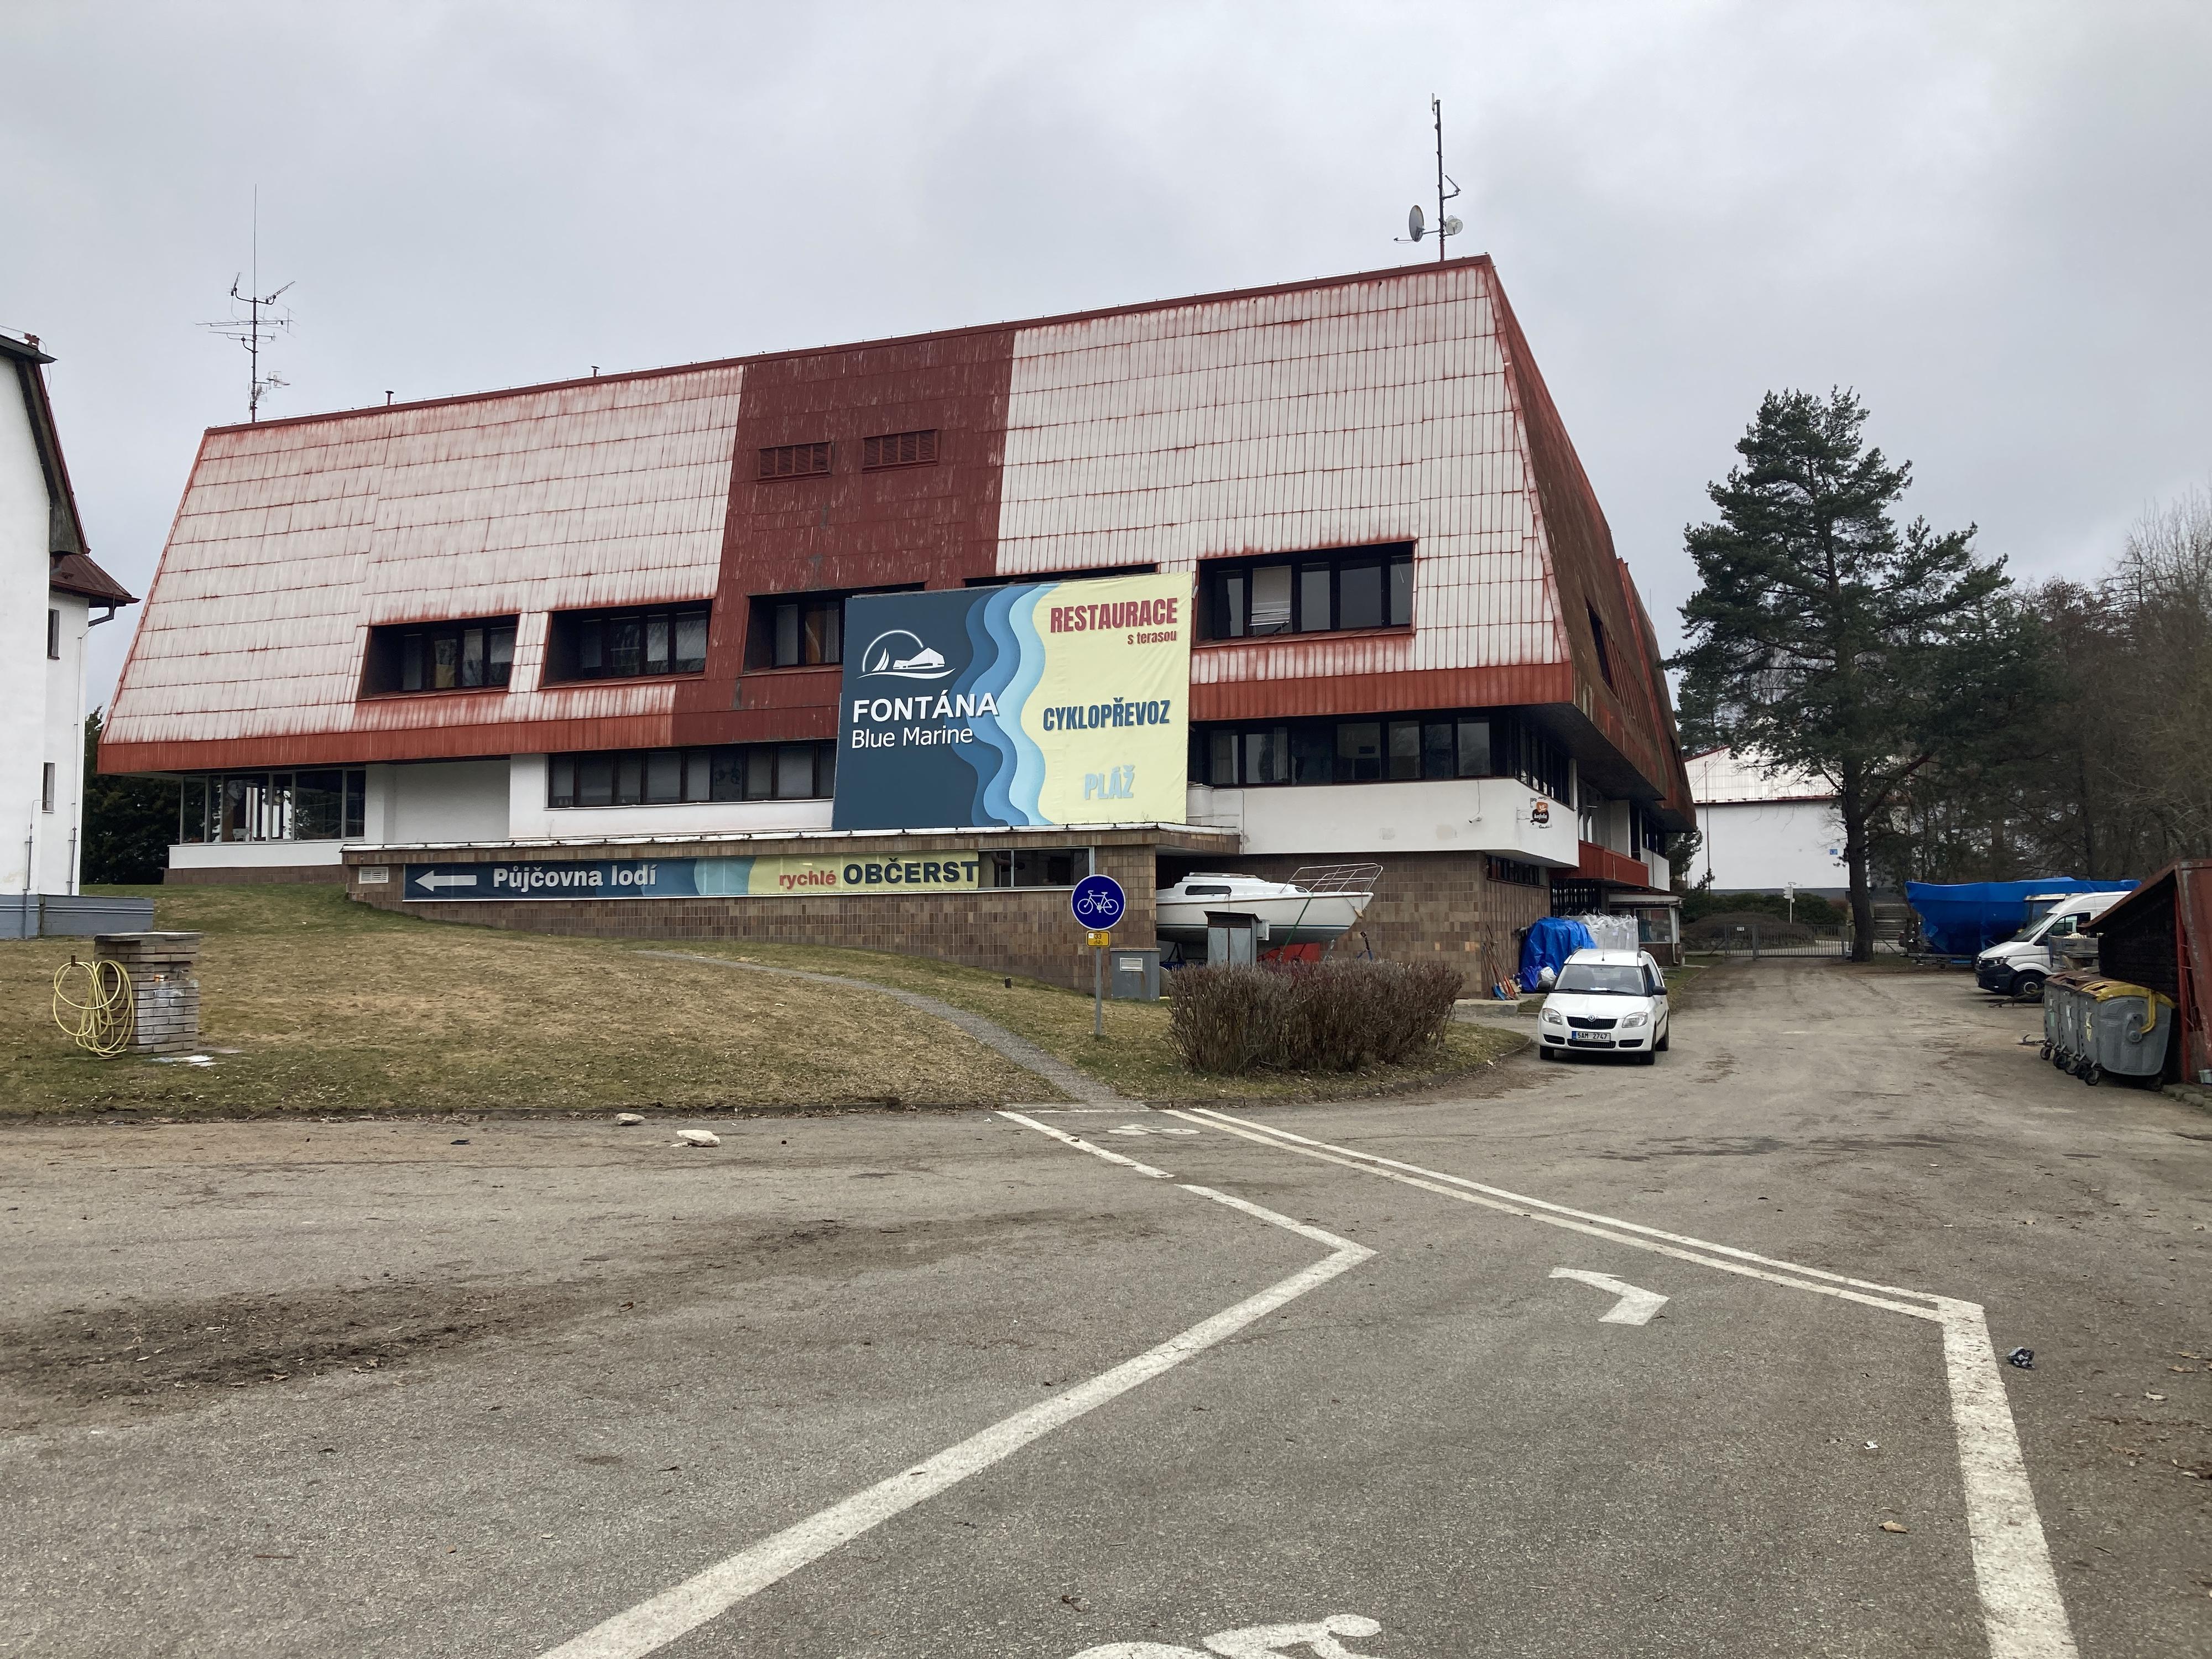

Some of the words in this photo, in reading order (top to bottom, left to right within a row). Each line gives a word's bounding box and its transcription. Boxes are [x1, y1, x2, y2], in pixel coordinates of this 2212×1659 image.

[1050, 597, 1178, 633] RESTAURACE
[1126, 634, 1134, 645] s
[1136, 629, 1177, 643] terasou
[853, 690, 999, 723] FONTÁNA
[1043, 697, 1170, 731] CYKLOPŘEVOZ
[852, 727, 896, 749] Blue
[903, 725, 974, 747] Marine
[1083, 764, 1135, 801] PLÁŽ
[493, 865, 603, 892] Půjčovna
[611, 864, 656, 886] lodí
[779, 870, 836, 890] rychlé
[843, 857, 979, 884] OBČERST
